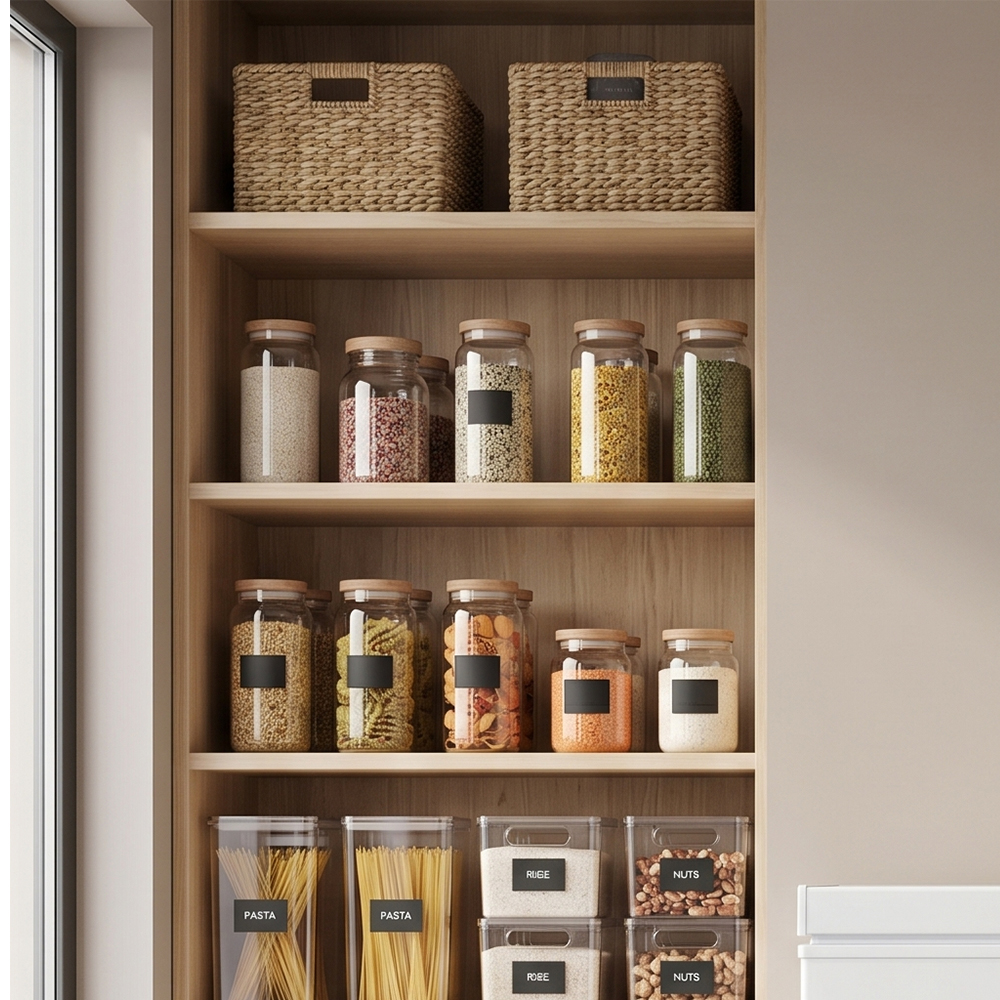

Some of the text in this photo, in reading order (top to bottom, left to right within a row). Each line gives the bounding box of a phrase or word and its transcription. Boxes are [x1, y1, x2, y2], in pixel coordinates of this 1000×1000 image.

[673, 870, 700, 879] NUTS
[244, 911, 276, 920] PASTA
[380, 911, 412, 920] PASTA
[673, 972, 700, 982] NUTS
